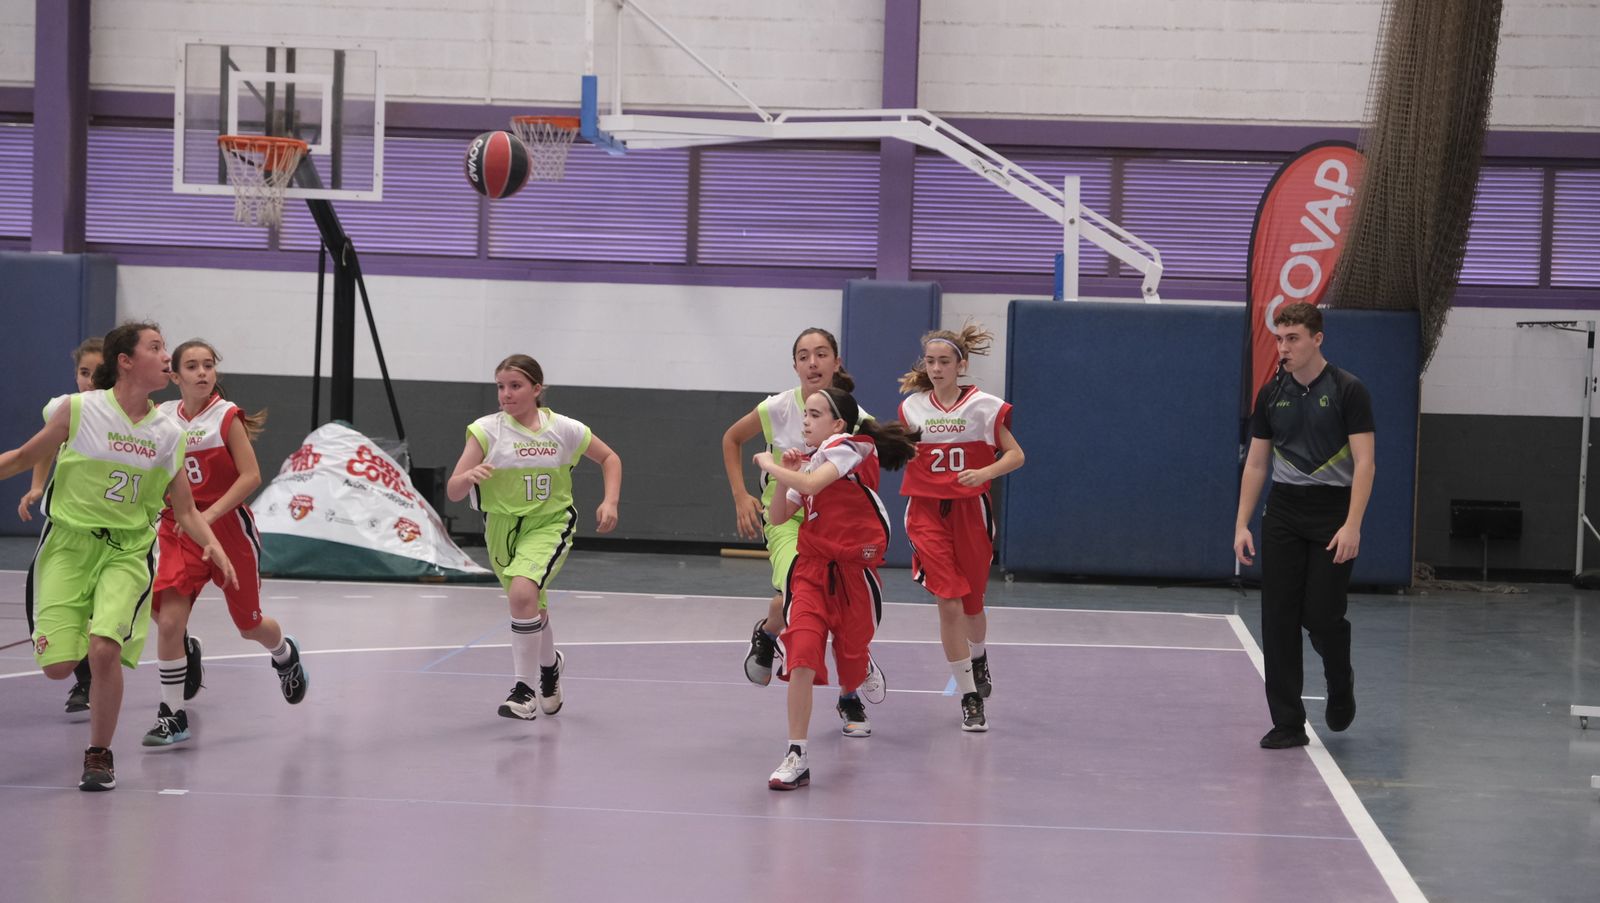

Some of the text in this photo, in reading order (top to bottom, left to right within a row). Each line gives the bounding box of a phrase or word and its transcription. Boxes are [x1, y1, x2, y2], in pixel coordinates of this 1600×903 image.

[468, 139, 483, 182] COVAP
[1265, 159, 1354, 335] COVAP
[926, 417, 966, 425] Muévete
[929, 425, 965, 433] COVAP
[113, 442, 156, 458] COVAP
[186, 436, 202, 445] VAP
[519, 448, 557, 456] COVAP
[185, 457, 203, 484] 8
[930, 446, 966, 473] 20
[104, 470, 142, 503] 21
[523, 472, 552, 502] 19
